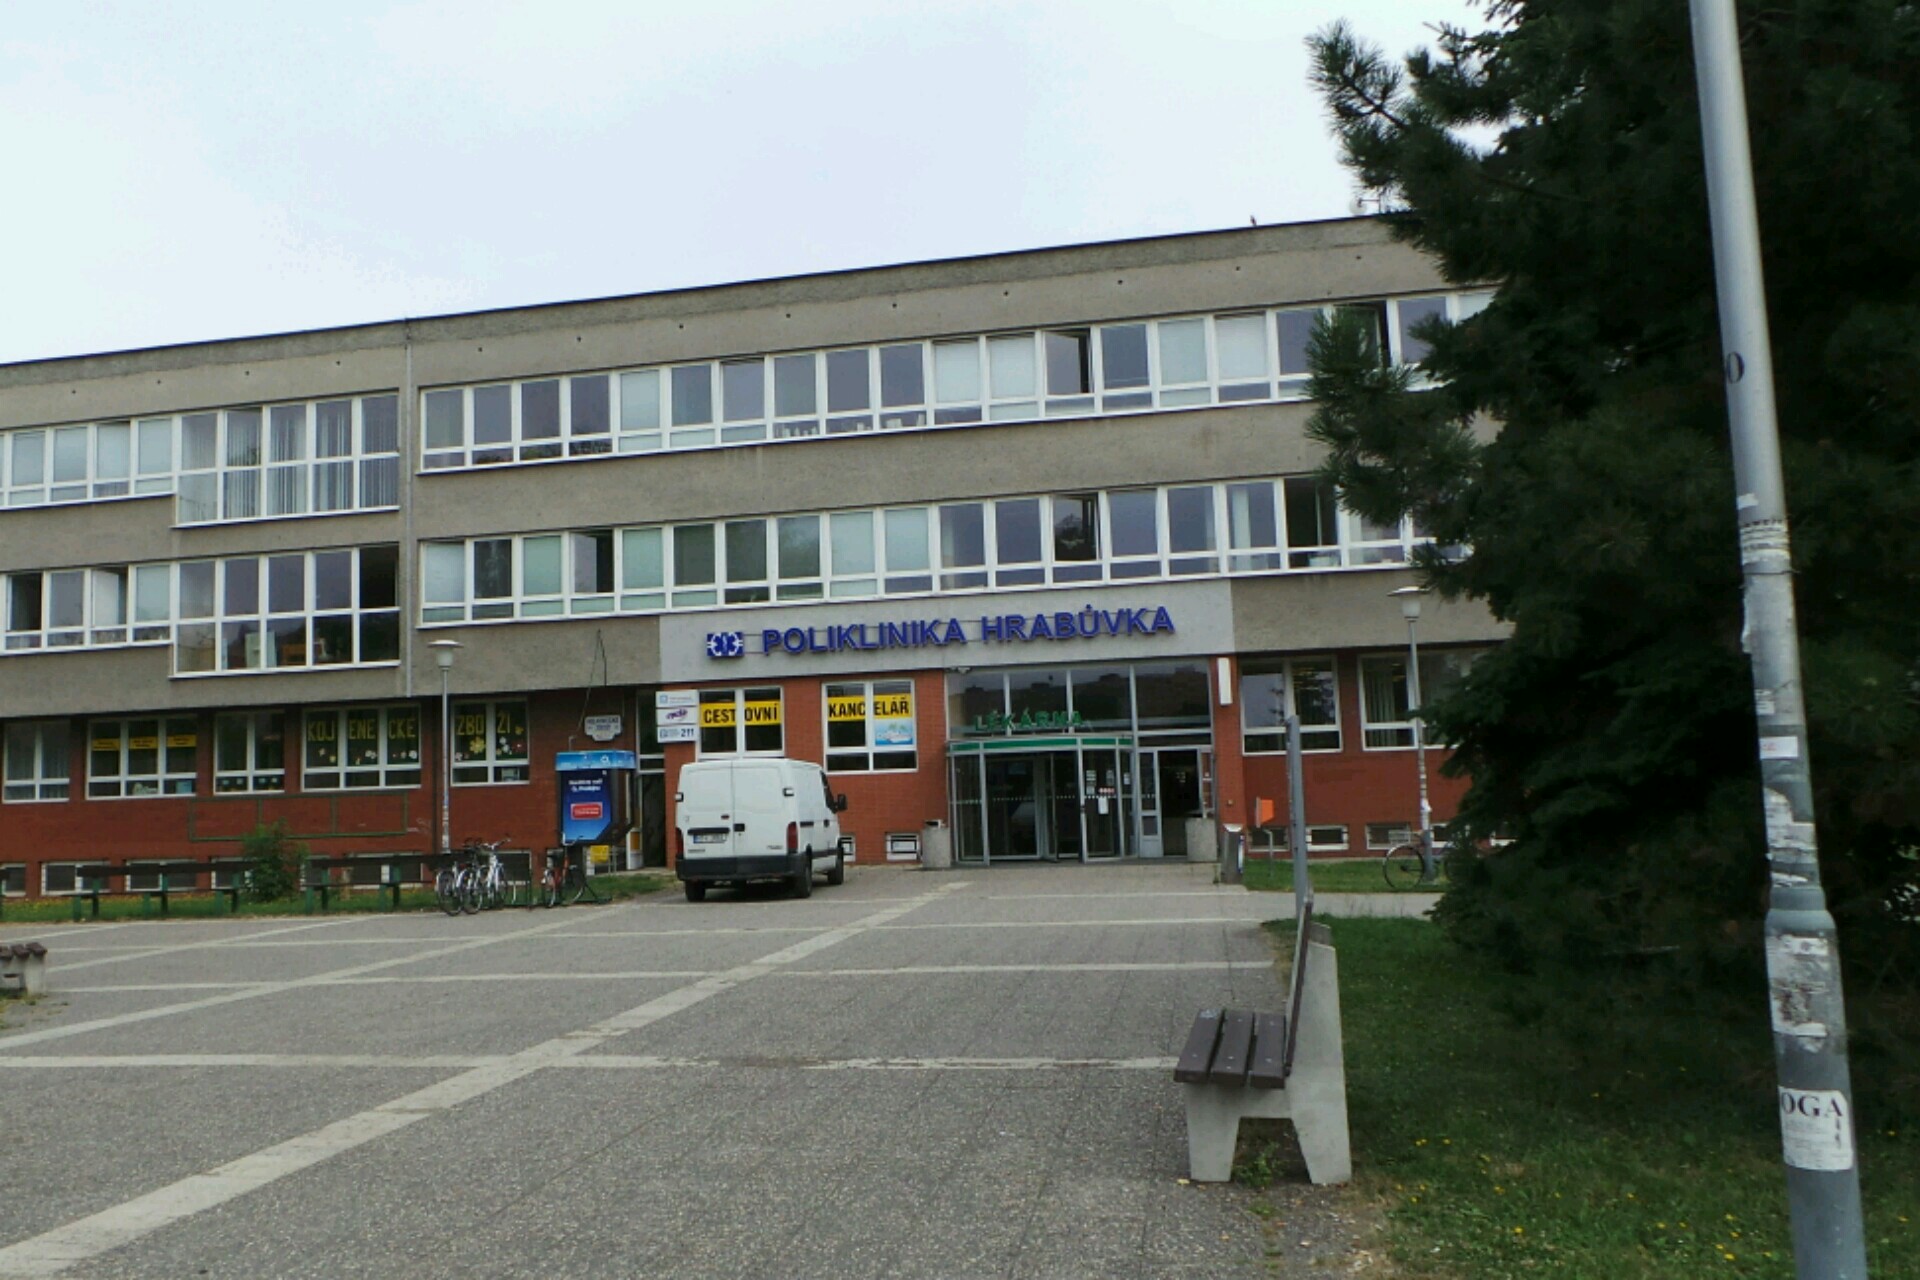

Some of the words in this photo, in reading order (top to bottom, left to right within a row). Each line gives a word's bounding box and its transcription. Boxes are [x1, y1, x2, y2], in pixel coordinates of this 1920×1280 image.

[762, 617, 967, 656] POLIKLINIKA
[981, 604, 1175, 644] HRABŮVKA
[704, 703, 778, 724] CESTOVNÍ
[829, 696, 910, 718] KANCELÁŘ
